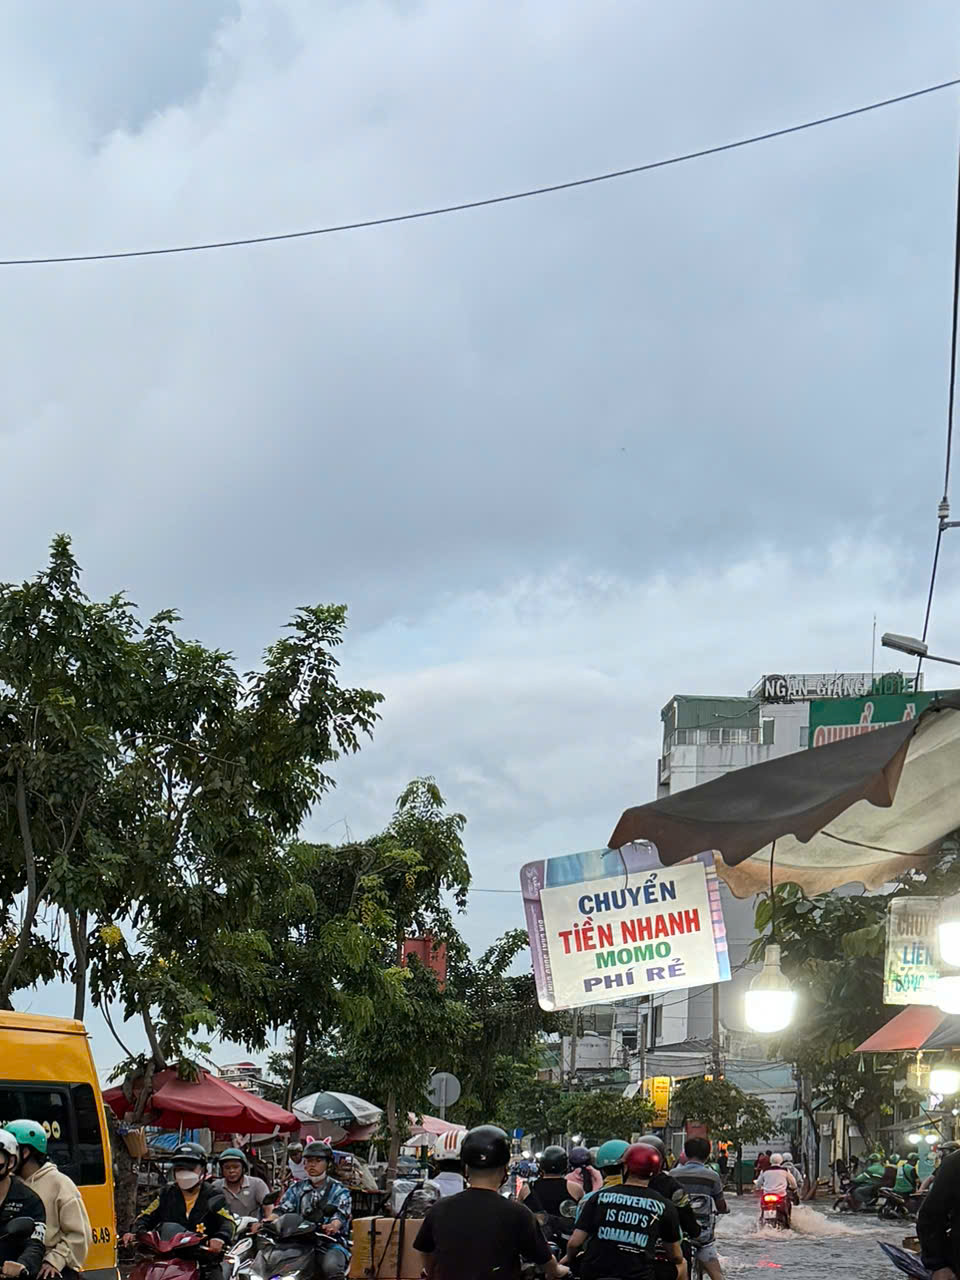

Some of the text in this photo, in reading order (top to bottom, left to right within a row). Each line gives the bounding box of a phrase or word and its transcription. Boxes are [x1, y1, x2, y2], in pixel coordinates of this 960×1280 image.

[872, 675, 916, 694] HOTE
[578, 872, 677, 915] CHUYỂN
[620, 908, 701, 945] NHANH
[595, 941, 672, 969] MOMO
[583, 957, 687, 993] PHÍ RẺ
[605, 1208, 649, 1228] IS GOD'S
[597, 1226, 649, 1248] COMMAND
